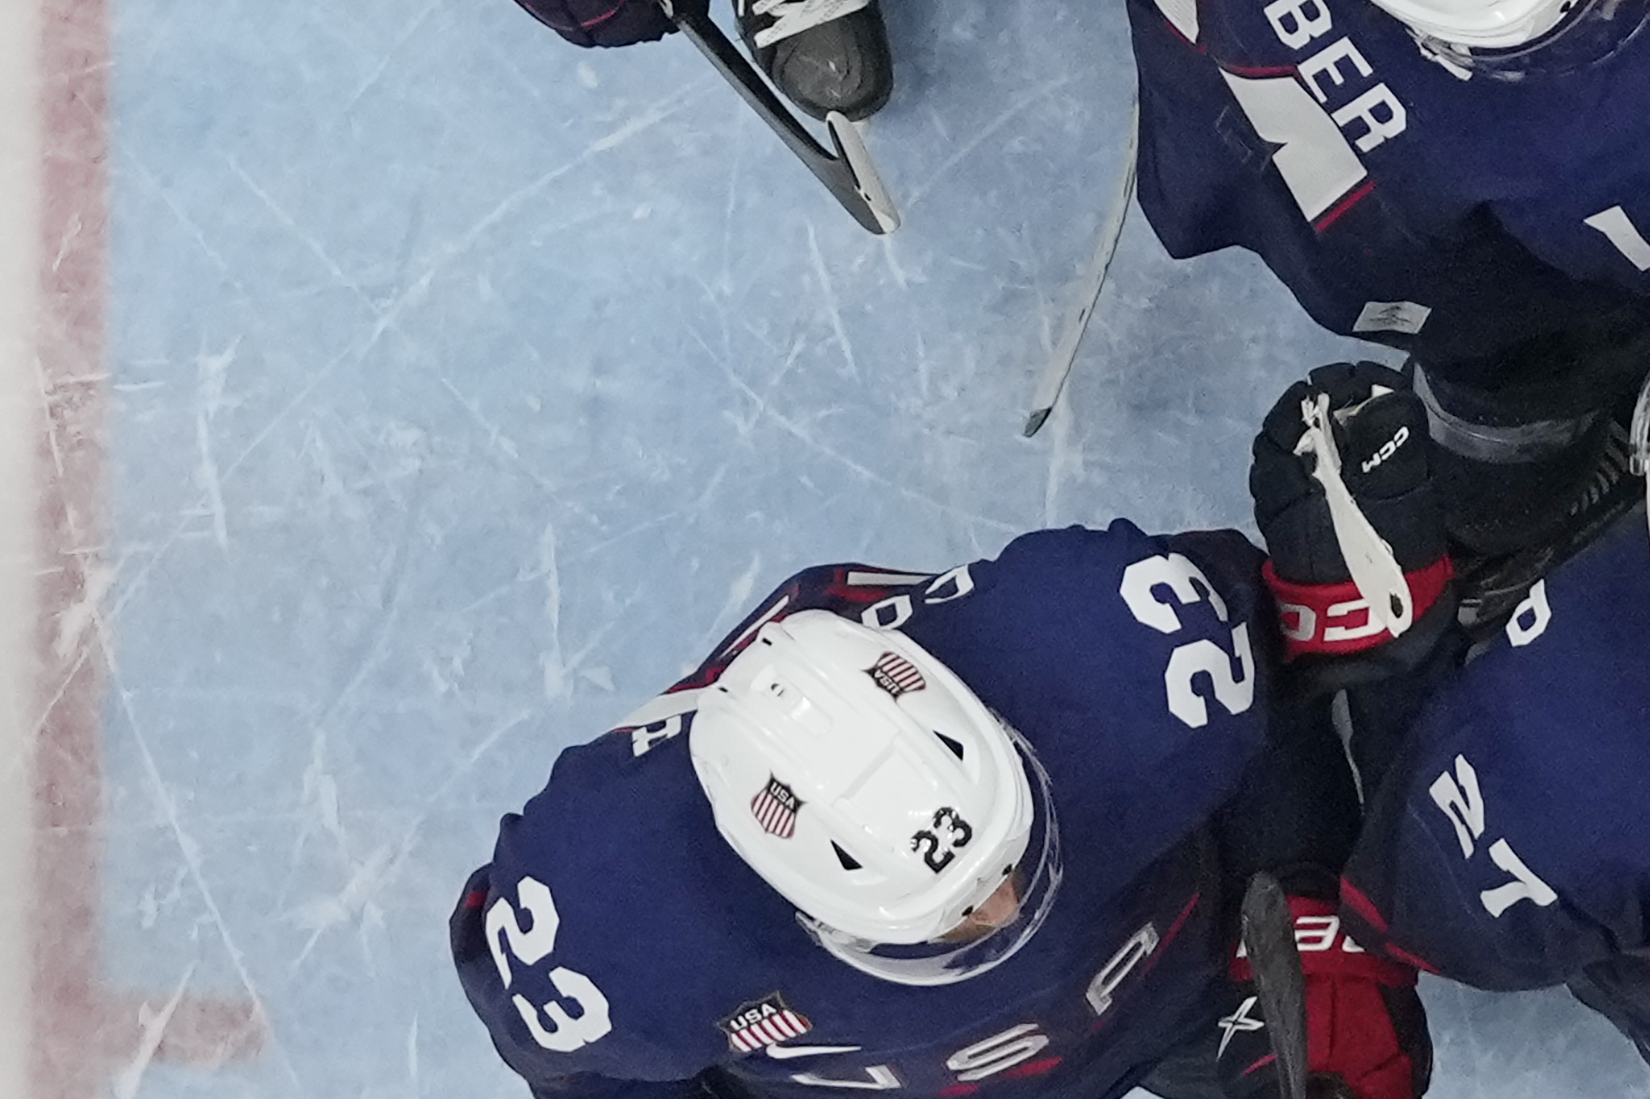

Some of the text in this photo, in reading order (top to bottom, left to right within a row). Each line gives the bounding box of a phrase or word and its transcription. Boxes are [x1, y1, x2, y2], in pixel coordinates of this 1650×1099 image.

[1362, 426, 1410, 473] CCM
[1119, 552, 1256, 728] 23
[873, 669, 900, 696] USA
[769, 780, 796, 808] USA
[911, 806, 973, 874] 23
[484, 876, 612, 1053] 23
[730, 1003, 777, 1032] USA
